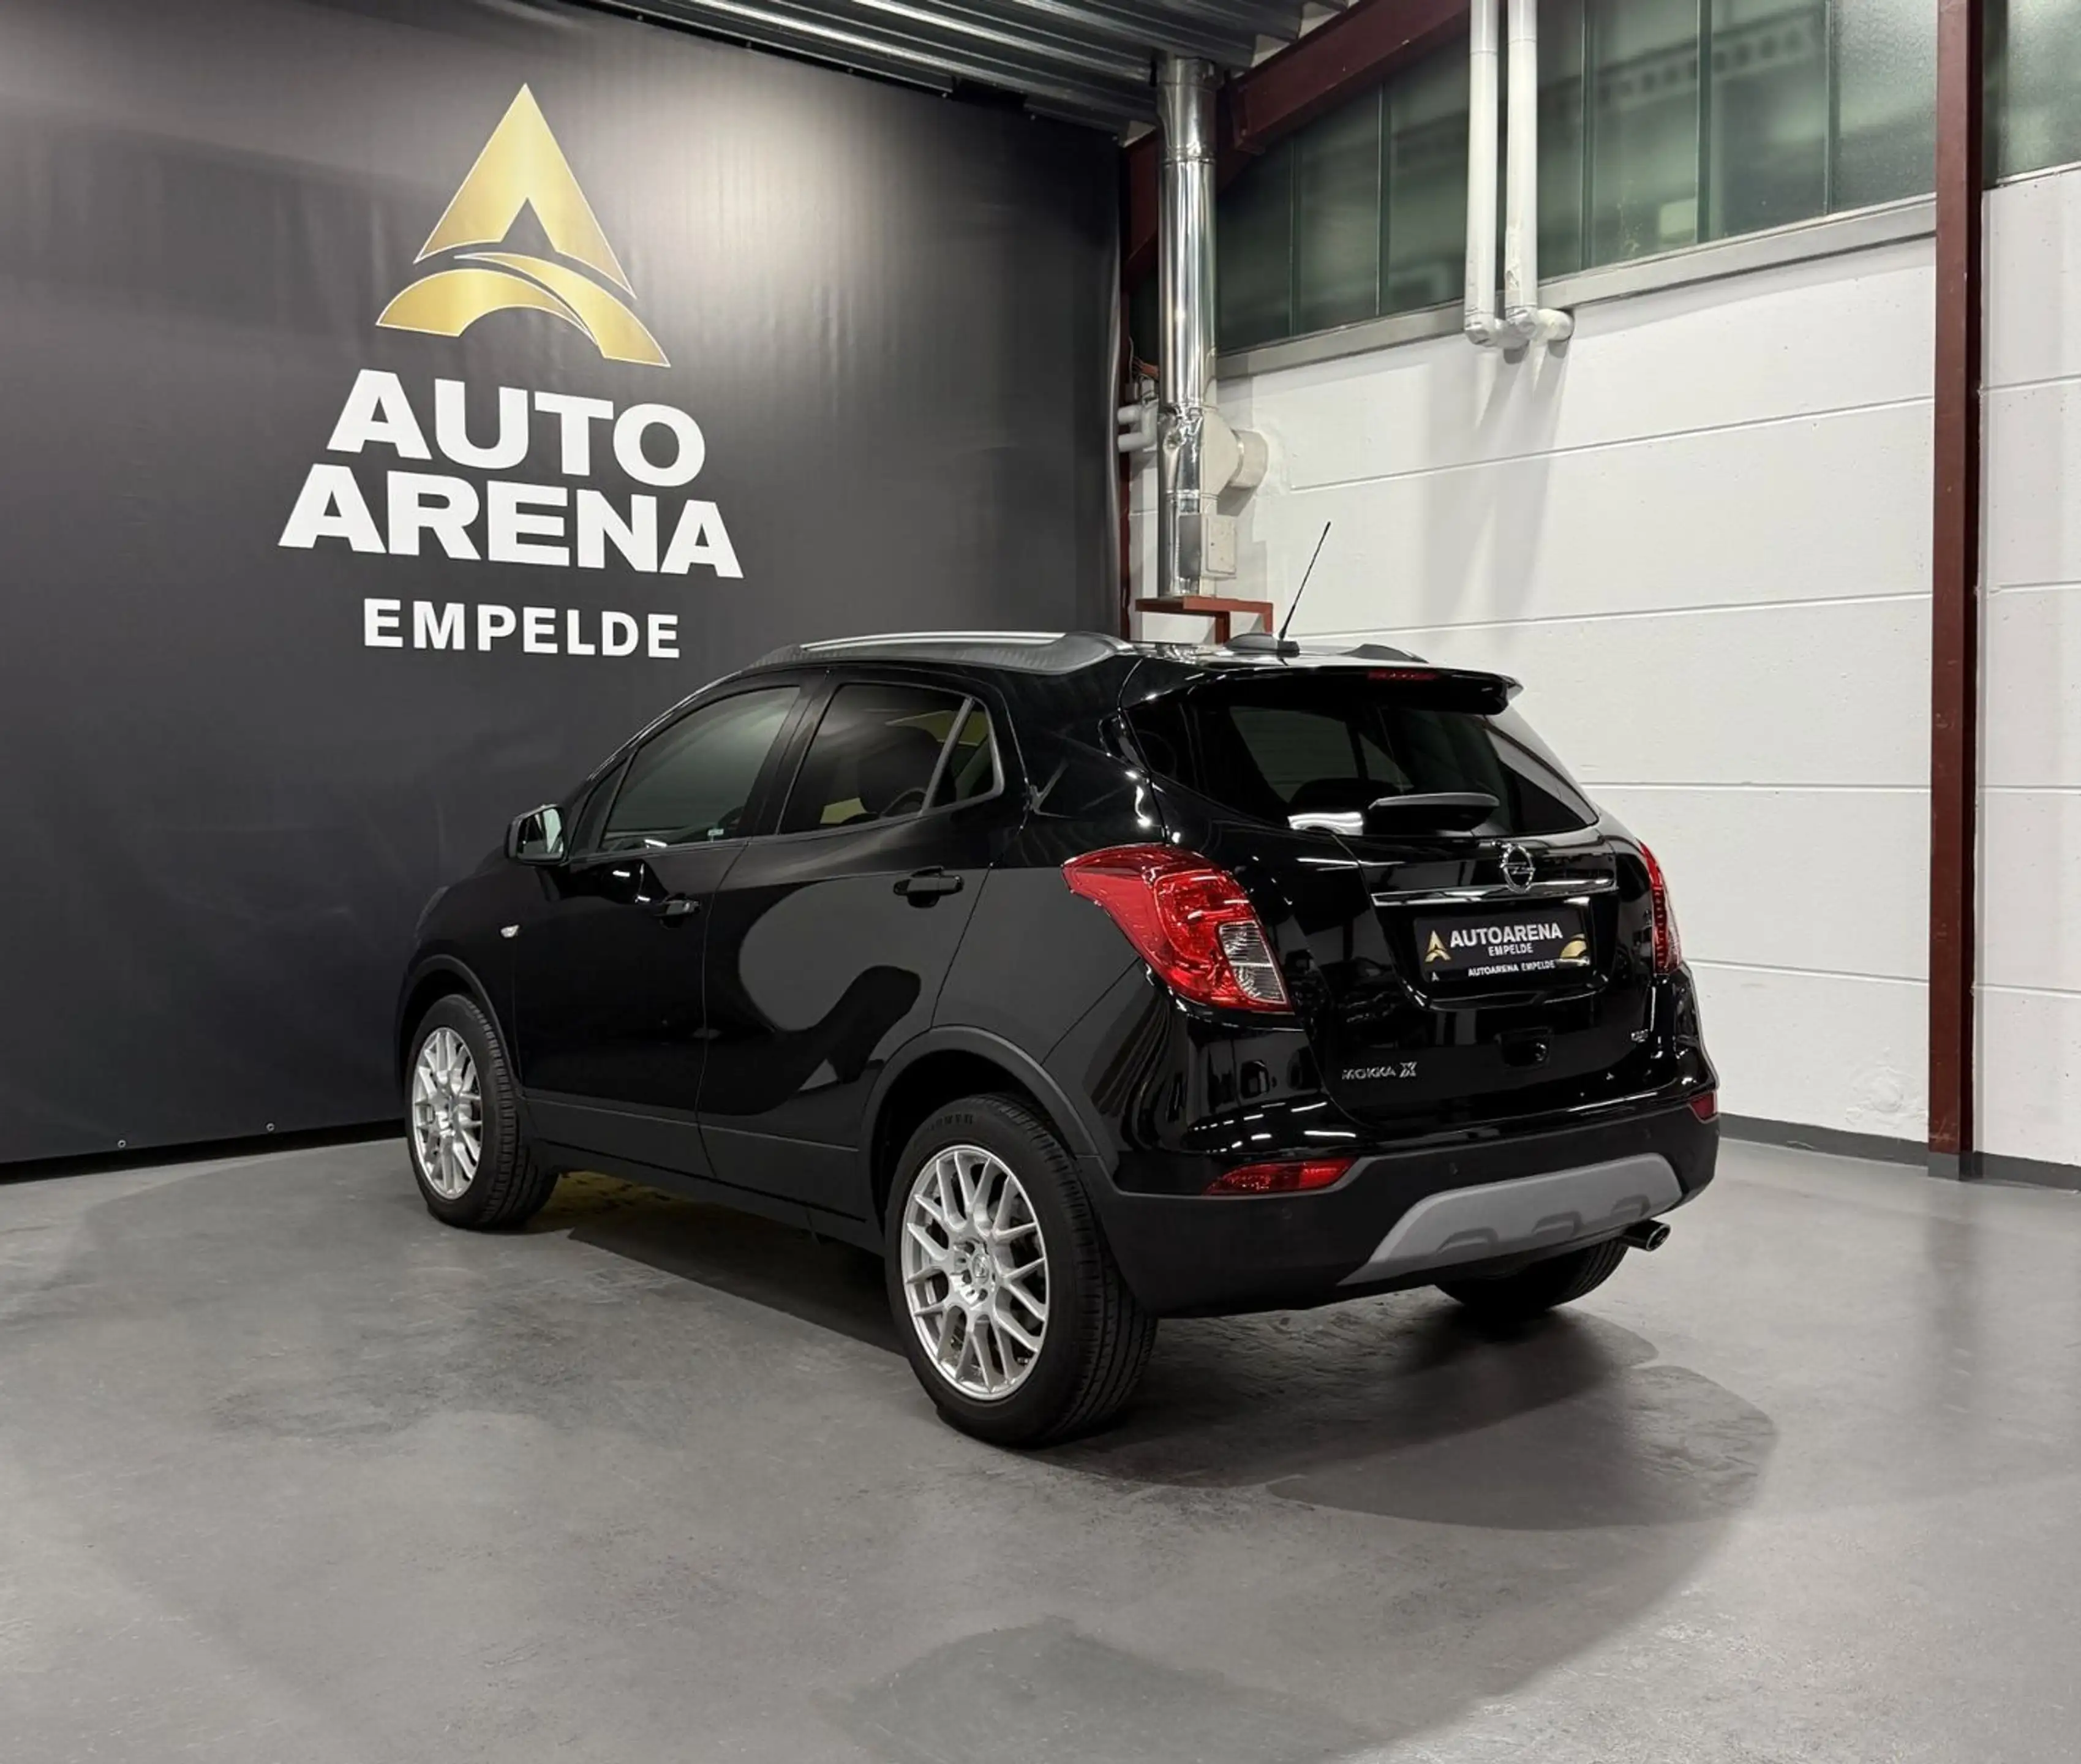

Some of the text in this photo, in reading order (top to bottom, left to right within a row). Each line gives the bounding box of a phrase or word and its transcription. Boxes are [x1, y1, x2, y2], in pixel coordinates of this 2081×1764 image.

[326, 369, 706, 487] AUTO
[278, 463, 744, 578] ARENA
[364, 598, 680, 658] EMPELDE
[1450, 922, 1563, 948] AUTOARENA
[1488, 943, 1533, 957] EMPELDE
[1468, 960, 1556, 977] AUTOARENA EMPELDE
[1341, 1061, 1418, 1080] MOKKA X
